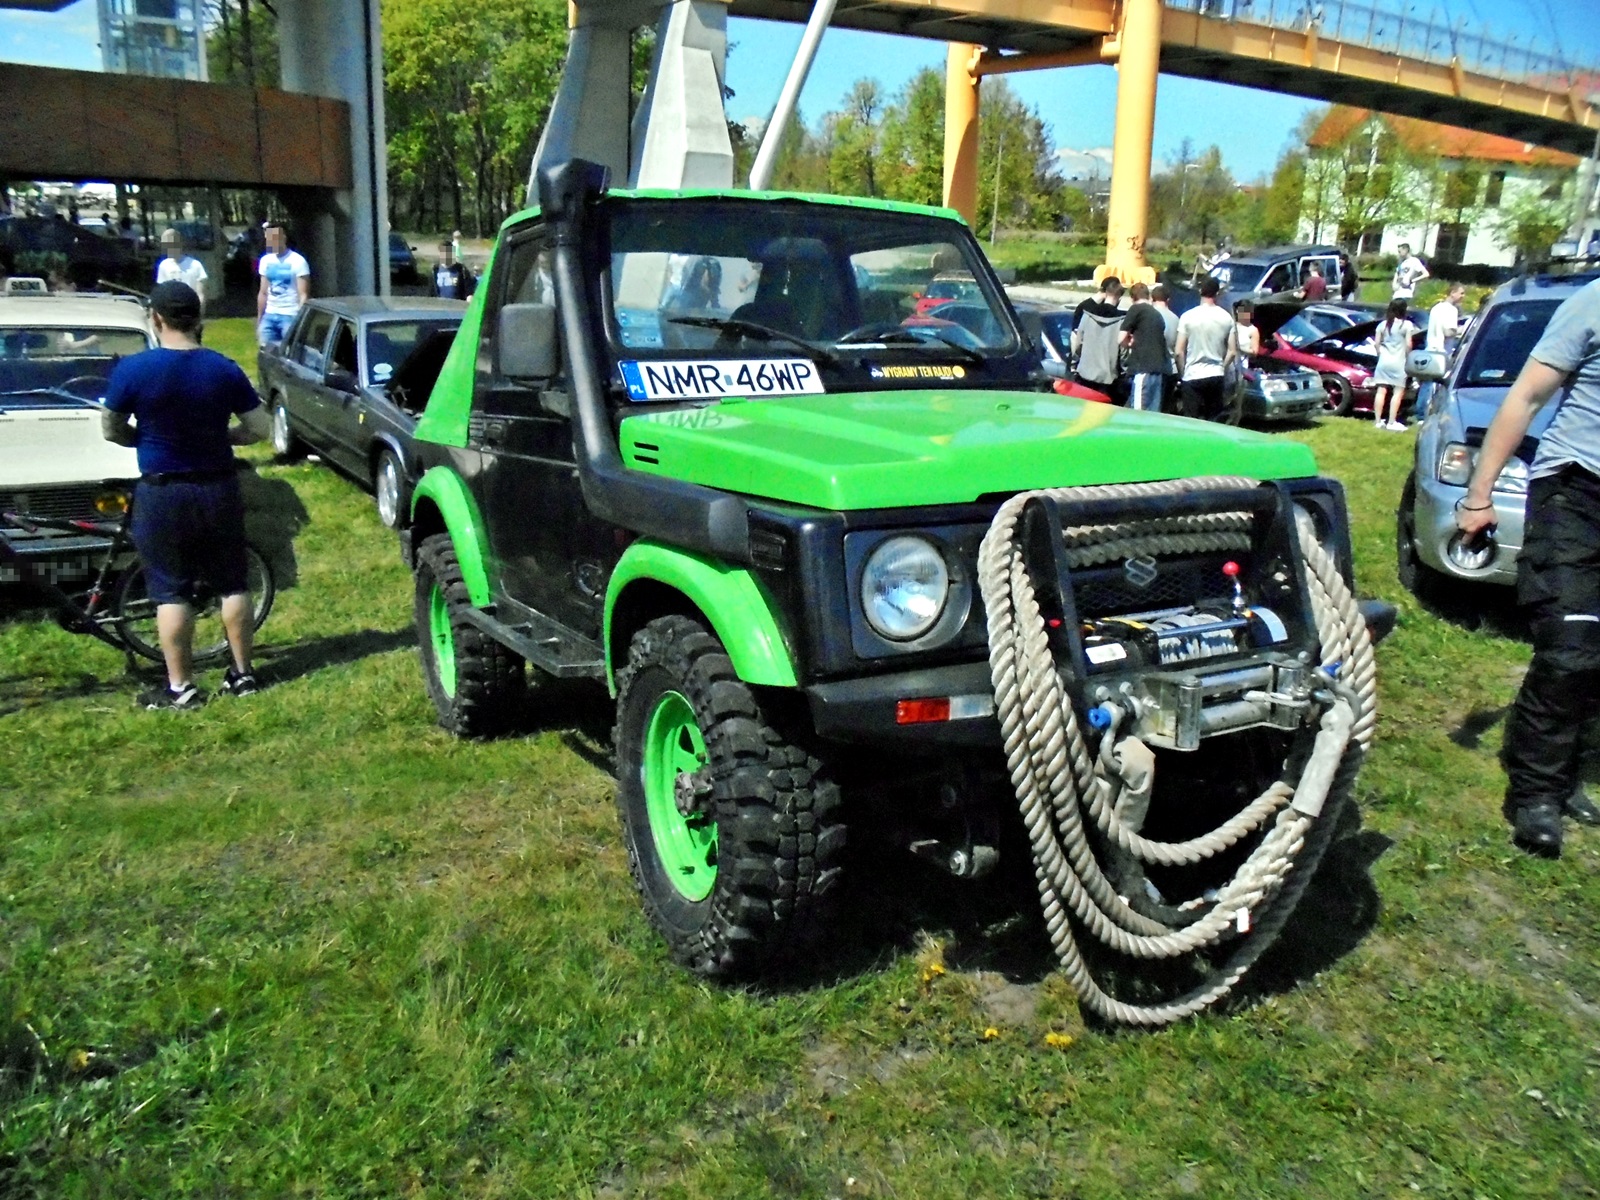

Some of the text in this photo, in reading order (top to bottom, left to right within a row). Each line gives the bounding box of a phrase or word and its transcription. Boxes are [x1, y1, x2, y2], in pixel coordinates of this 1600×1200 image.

[918, 366, 933, 378] TEN
[645, 363, 811, 395] NMR 46WP
[630, 384, 644, 394] PL
